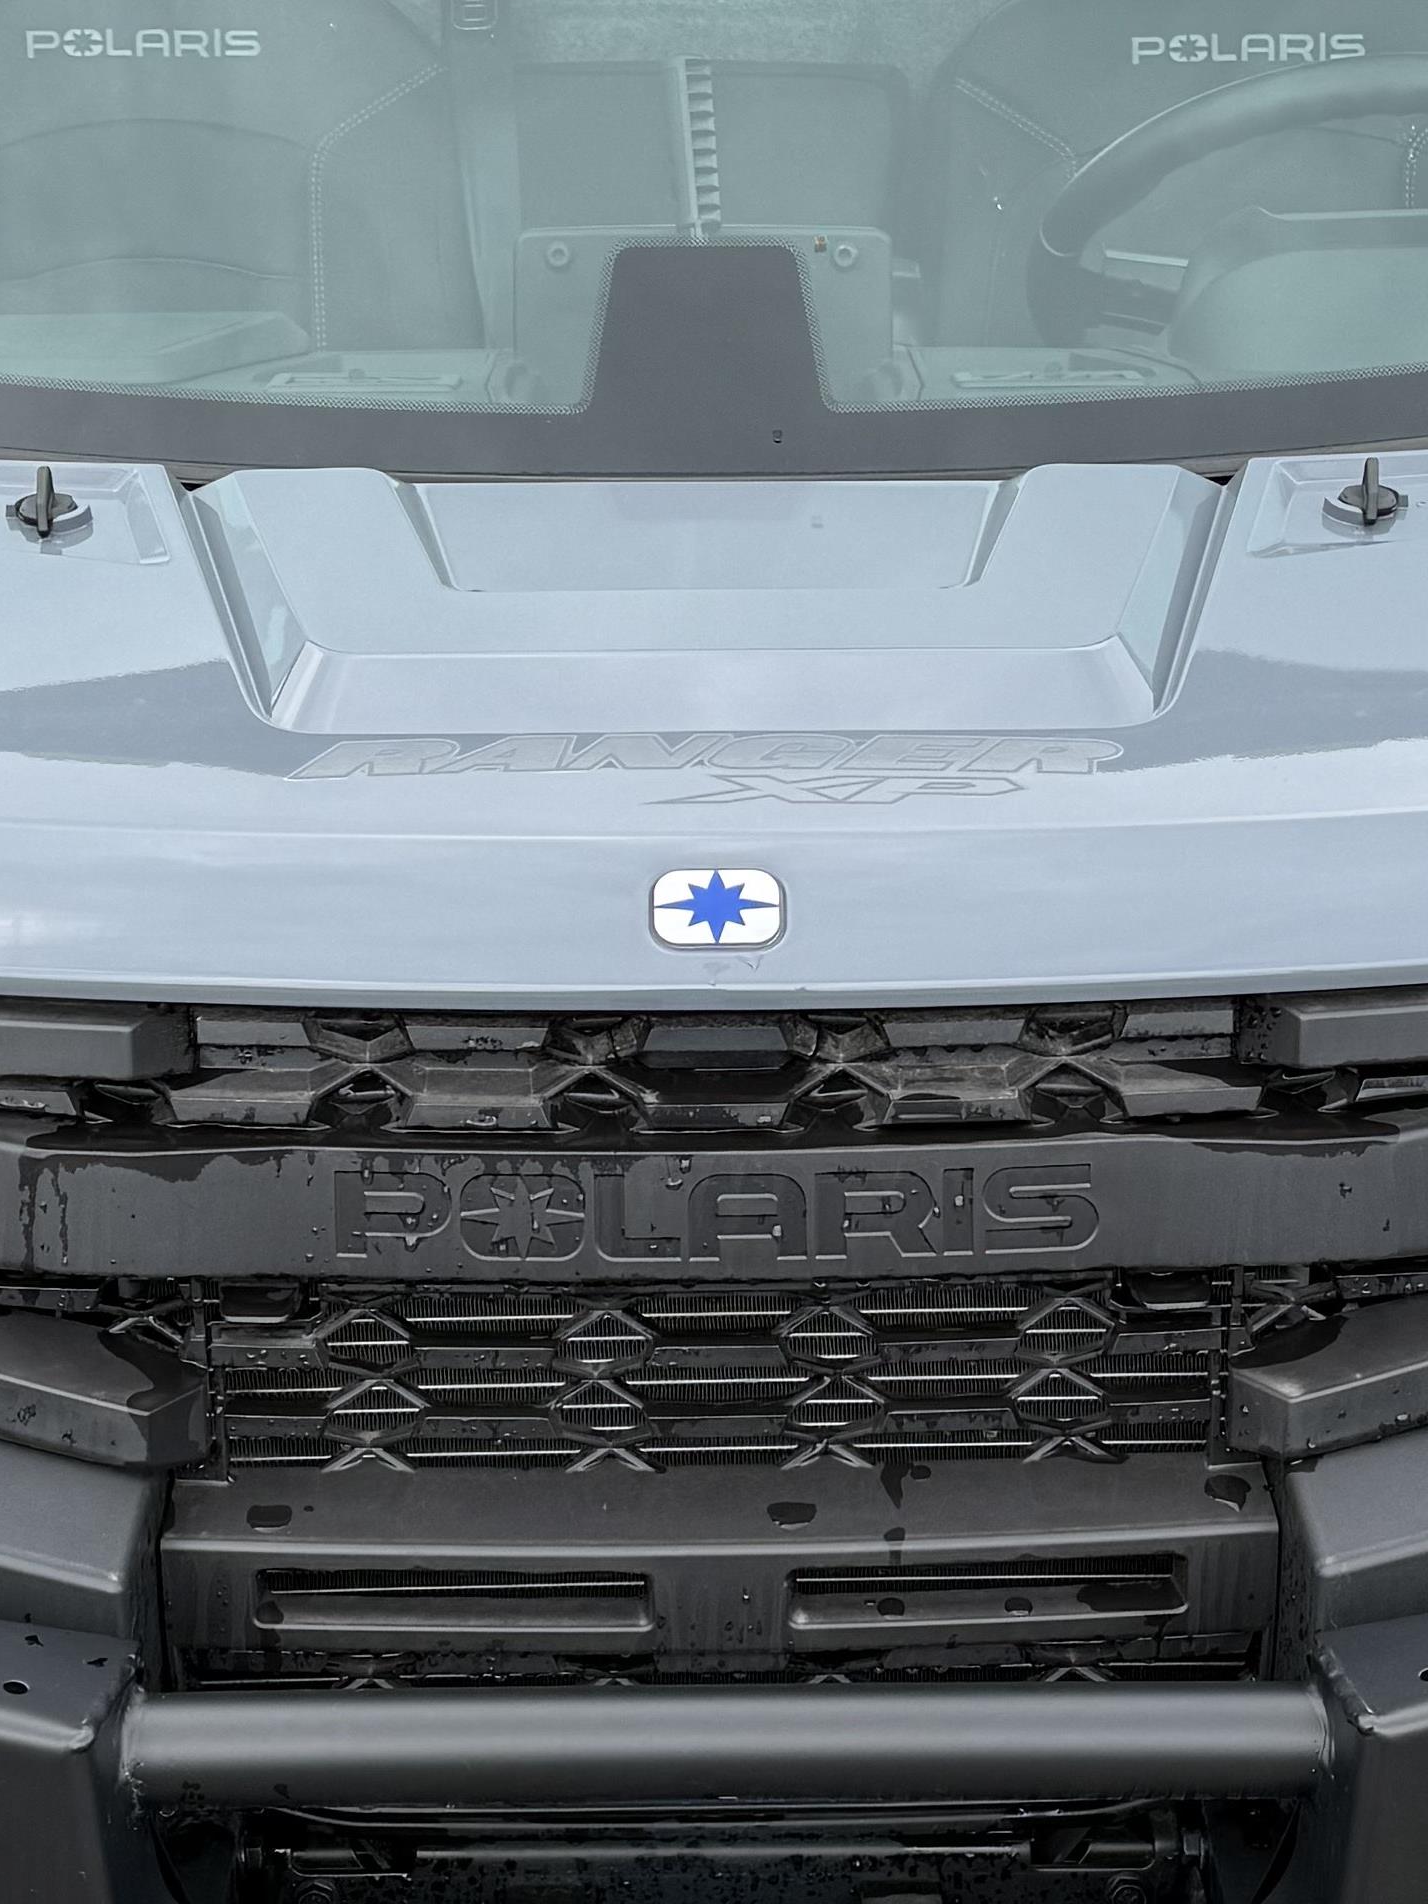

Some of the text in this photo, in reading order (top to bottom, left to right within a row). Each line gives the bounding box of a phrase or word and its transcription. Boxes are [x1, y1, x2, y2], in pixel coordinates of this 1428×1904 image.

[25, 27, 262, 59] POLARIS
[1131, 32, 1366, 65] POLARIS
[284, 733, 1125, 781] RANGER
[639, 773, 1025, 805] XP
[334, 1161, 1100, 1263] POLARIS
